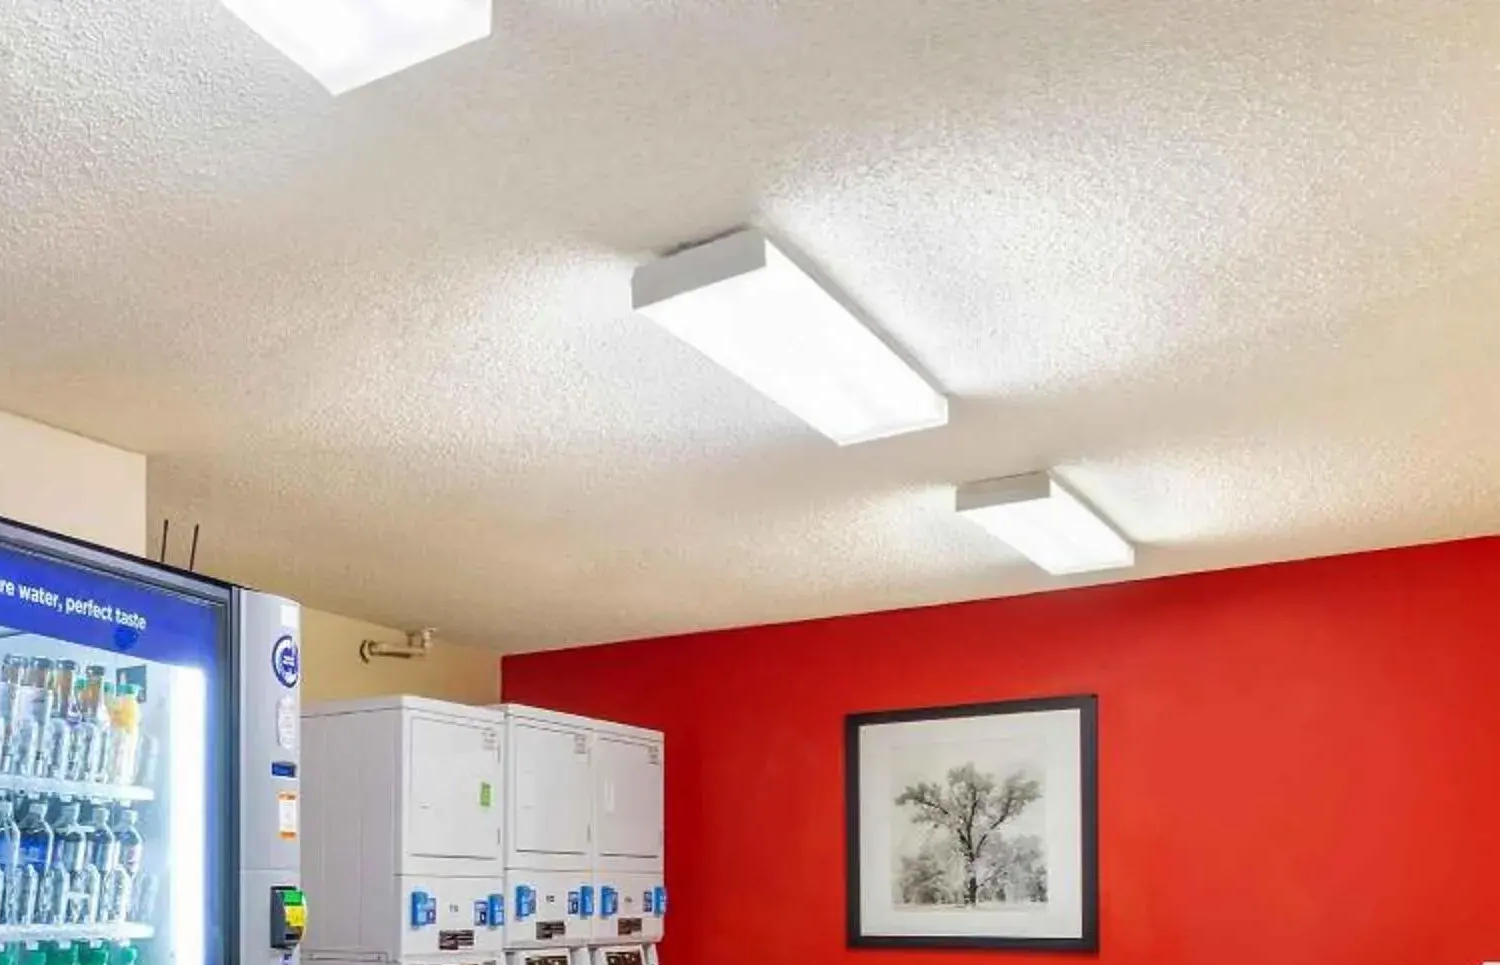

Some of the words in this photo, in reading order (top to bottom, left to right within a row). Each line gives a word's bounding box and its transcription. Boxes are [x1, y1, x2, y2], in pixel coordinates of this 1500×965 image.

[19, 583, 63, 612] water,
[65, 596, 113, 623] perfect
[115, 606, 147, 630] taste
